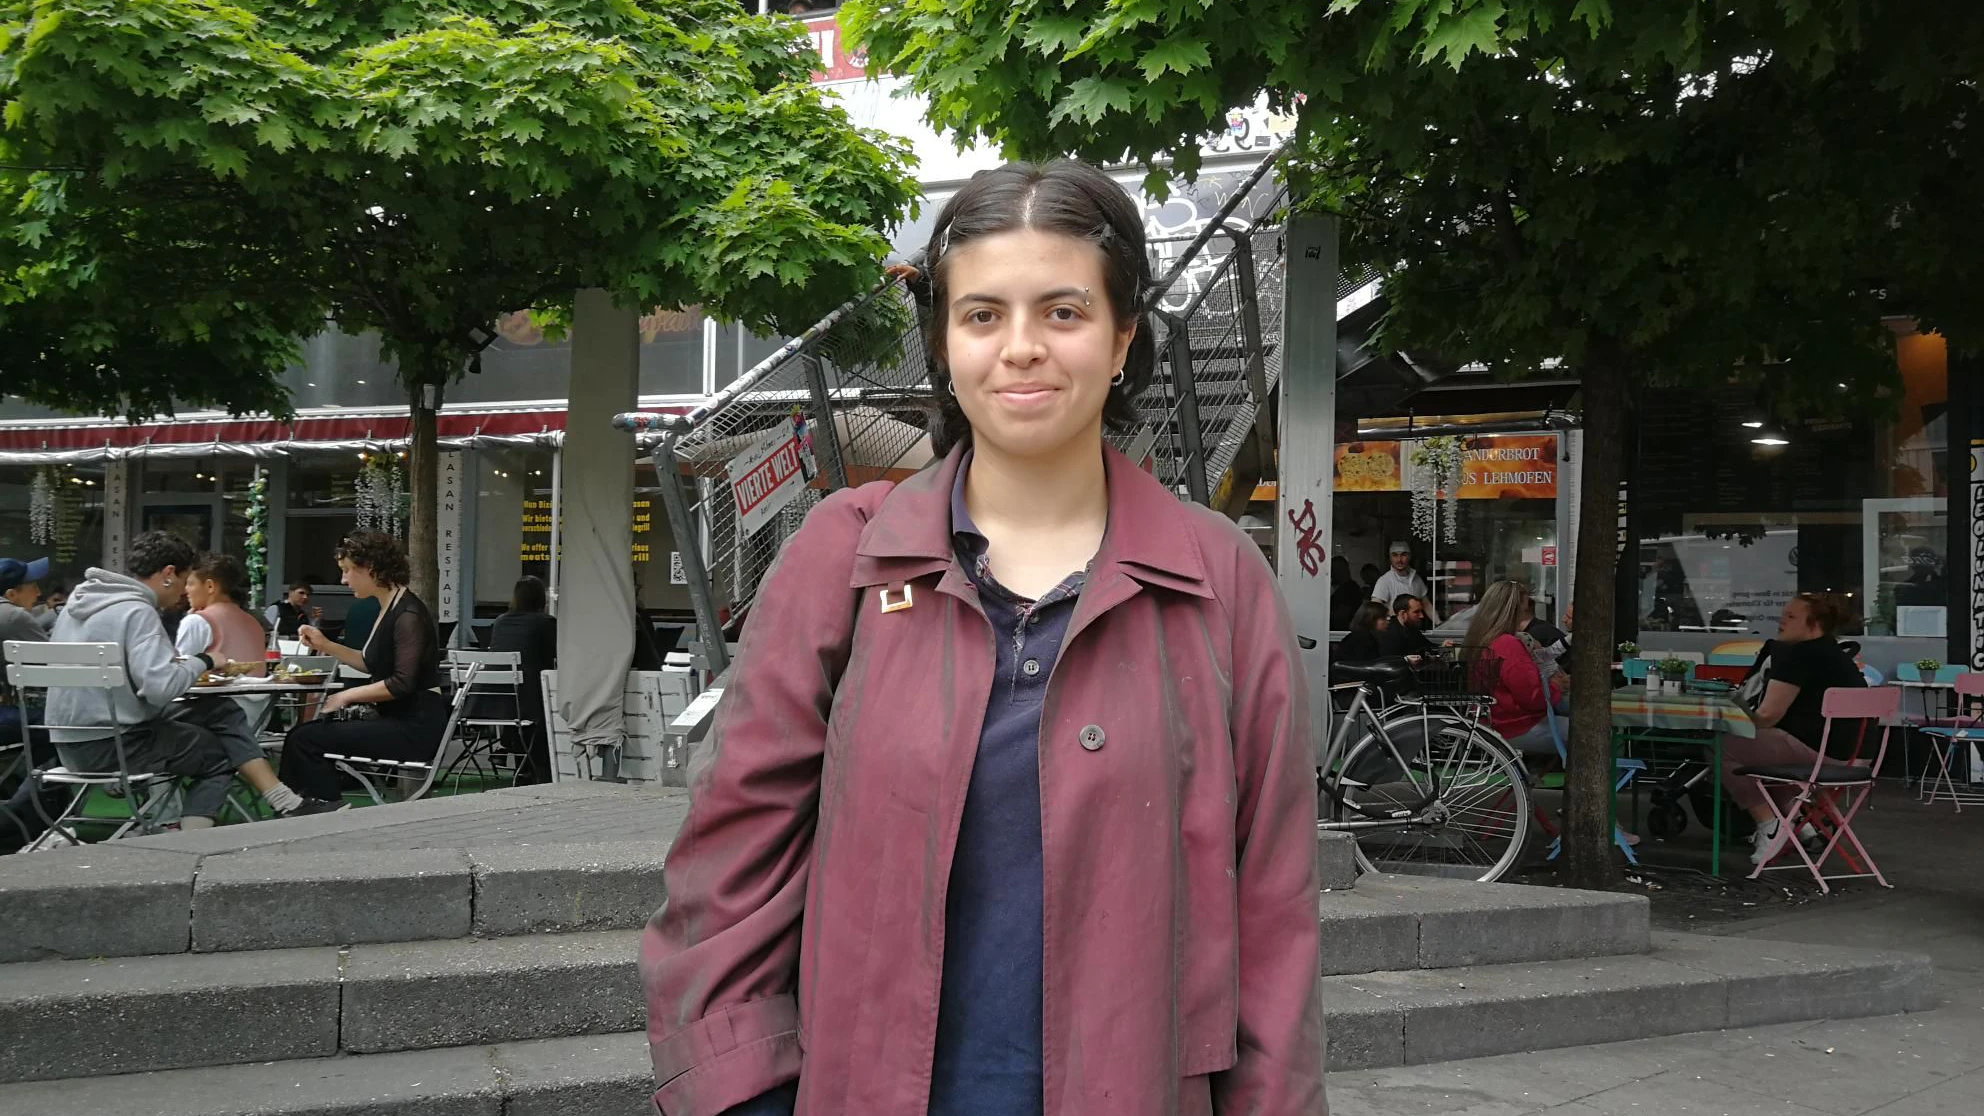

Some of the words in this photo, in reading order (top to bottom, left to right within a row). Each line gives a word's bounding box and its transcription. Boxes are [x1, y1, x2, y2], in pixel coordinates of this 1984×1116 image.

[444, 452, 455, 511] LASAN
[736, 461, 774, 511] VIERTE
[771, 442, 798, 482] WELT
[1483, 471, 1552, 484] LEHMOFEN
[442, 529, 454, 618] RESTAUR
